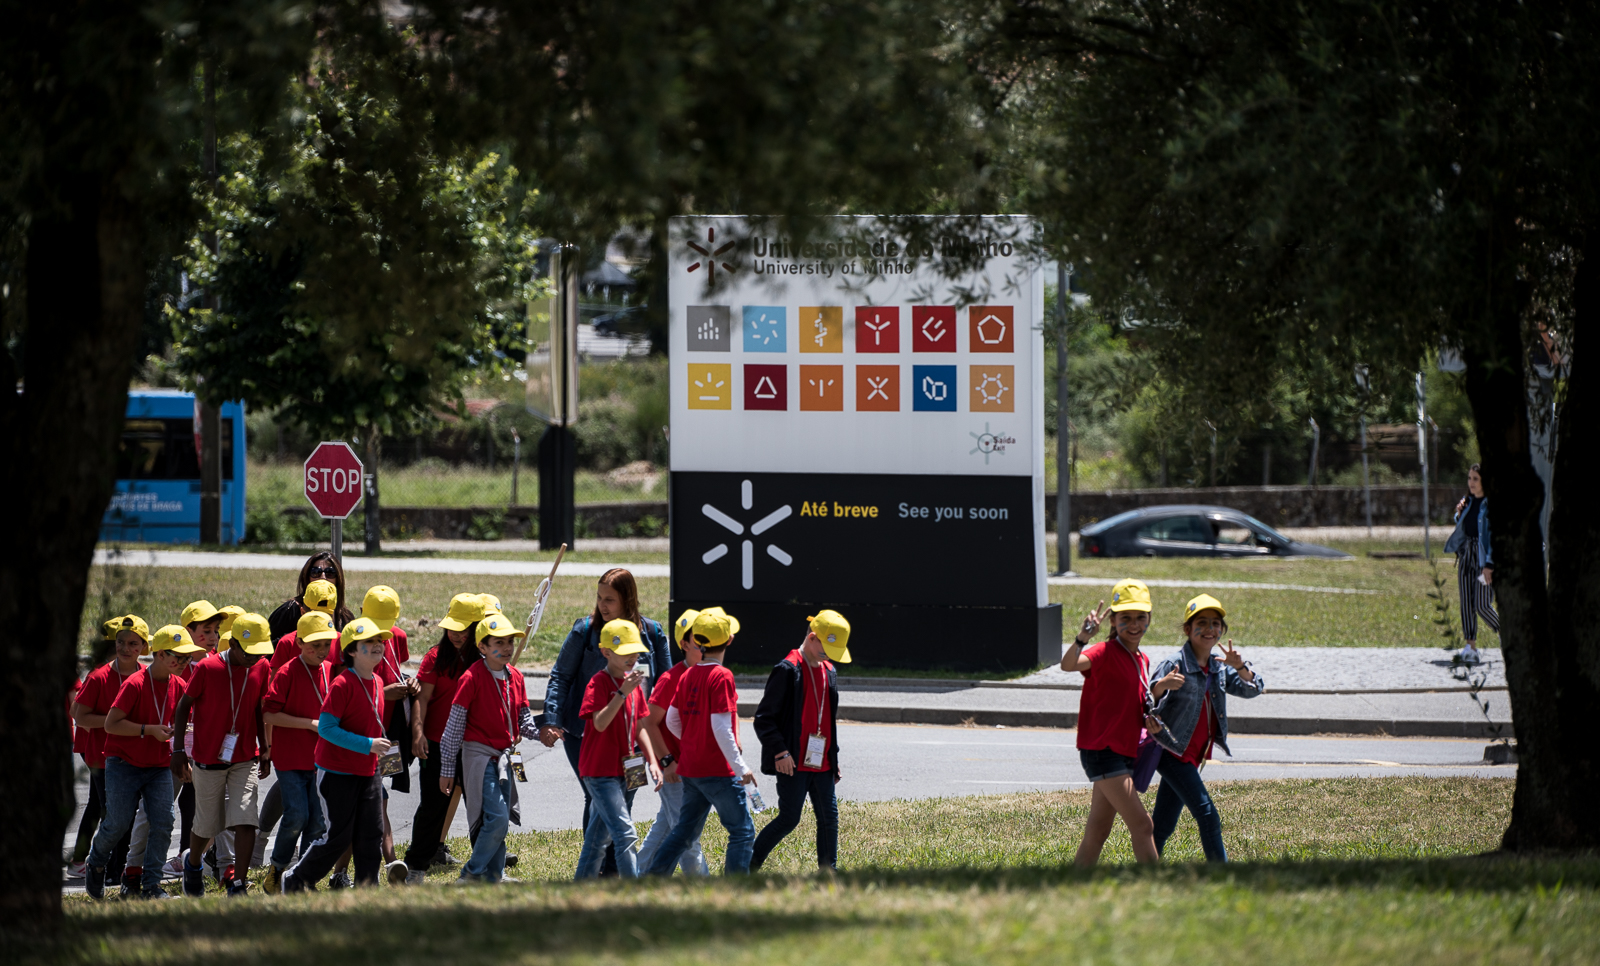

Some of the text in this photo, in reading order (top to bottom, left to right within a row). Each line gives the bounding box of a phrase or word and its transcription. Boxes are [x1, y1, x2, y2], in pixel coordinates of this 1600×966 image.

[753, 260, 914, 278] University of Minho
[307, 467, 360, 494] STOP
[800, 501, 879, 518] Até breve
[898, 502, 1009, 522] See you soon
